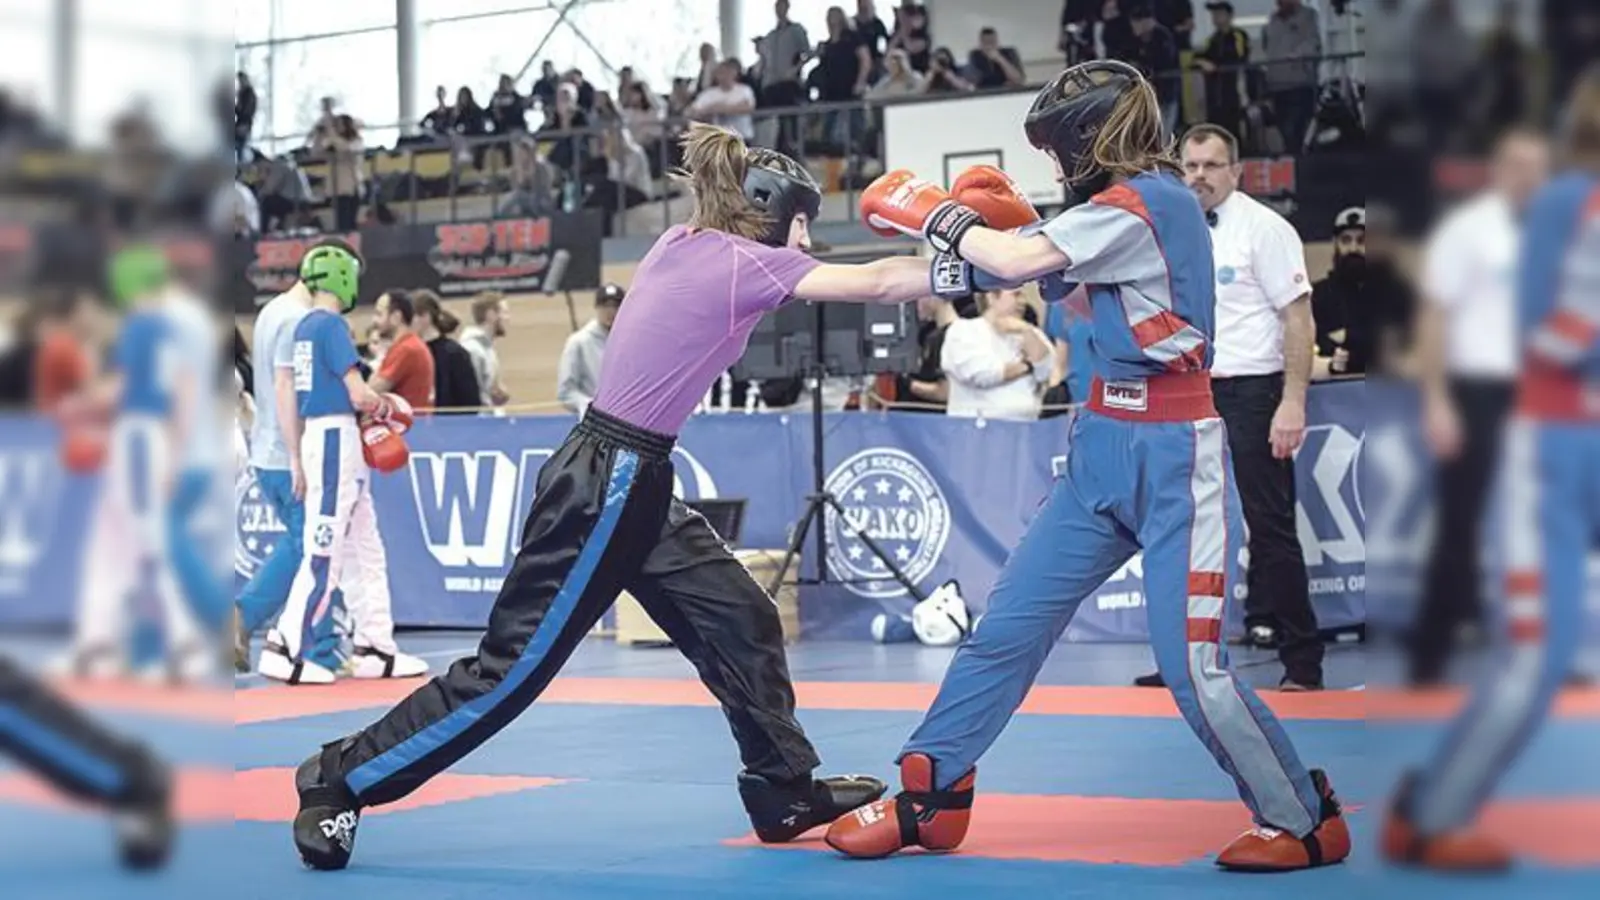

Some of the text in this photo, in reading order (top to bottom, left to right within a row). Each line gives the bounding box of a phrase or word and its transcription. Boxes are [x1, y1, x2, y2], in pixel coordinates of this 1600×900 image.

[841, 507, 923, 540] WAKO
[444, 577, 481, 592] WORLD
[1097, 591, 1141, 610] WORLD
